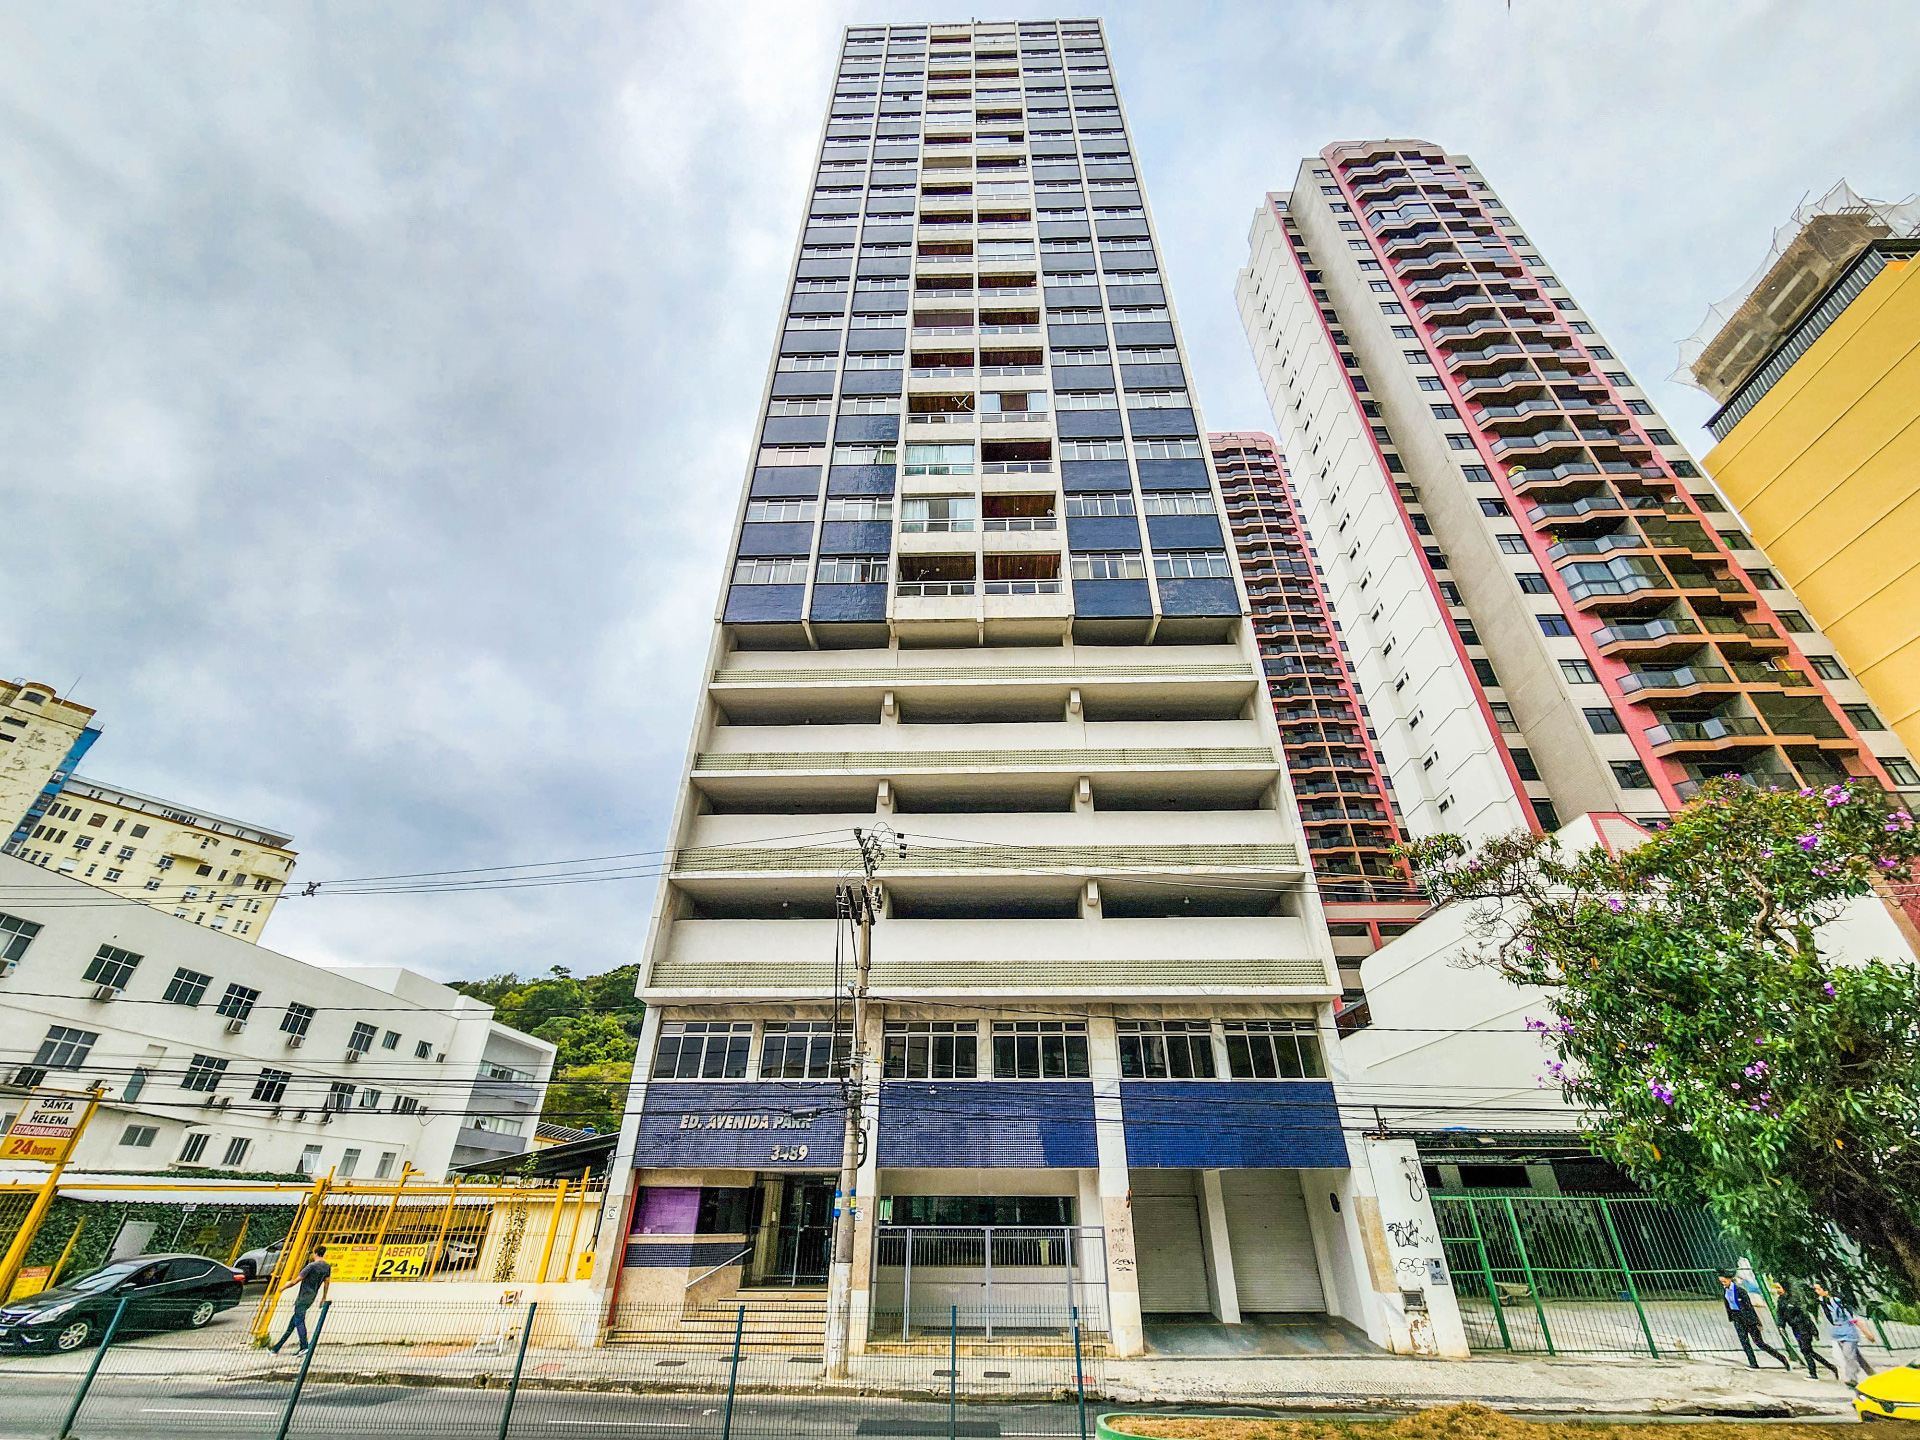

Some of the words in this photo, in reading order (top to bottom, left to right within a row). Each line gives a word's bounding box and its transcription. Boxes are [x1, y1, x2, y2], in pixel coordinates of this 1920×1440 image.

[41, 1099, 74, 1110] SANTA
[30, 1114, 69, 1125] HELENA
[680, 1114, 702, 1129] ED.
[705, 1114, 769, 1129] AVENIDA
[12, 1125, 74, 1137] ESTACIONAMENTOS
[9, 1139, 35, 1154] 24
[31, 1144, 56, 1156] horas
[770, 1144, 809, 1161] 3489
[385, 1246, 426, 1257] ABERTO
